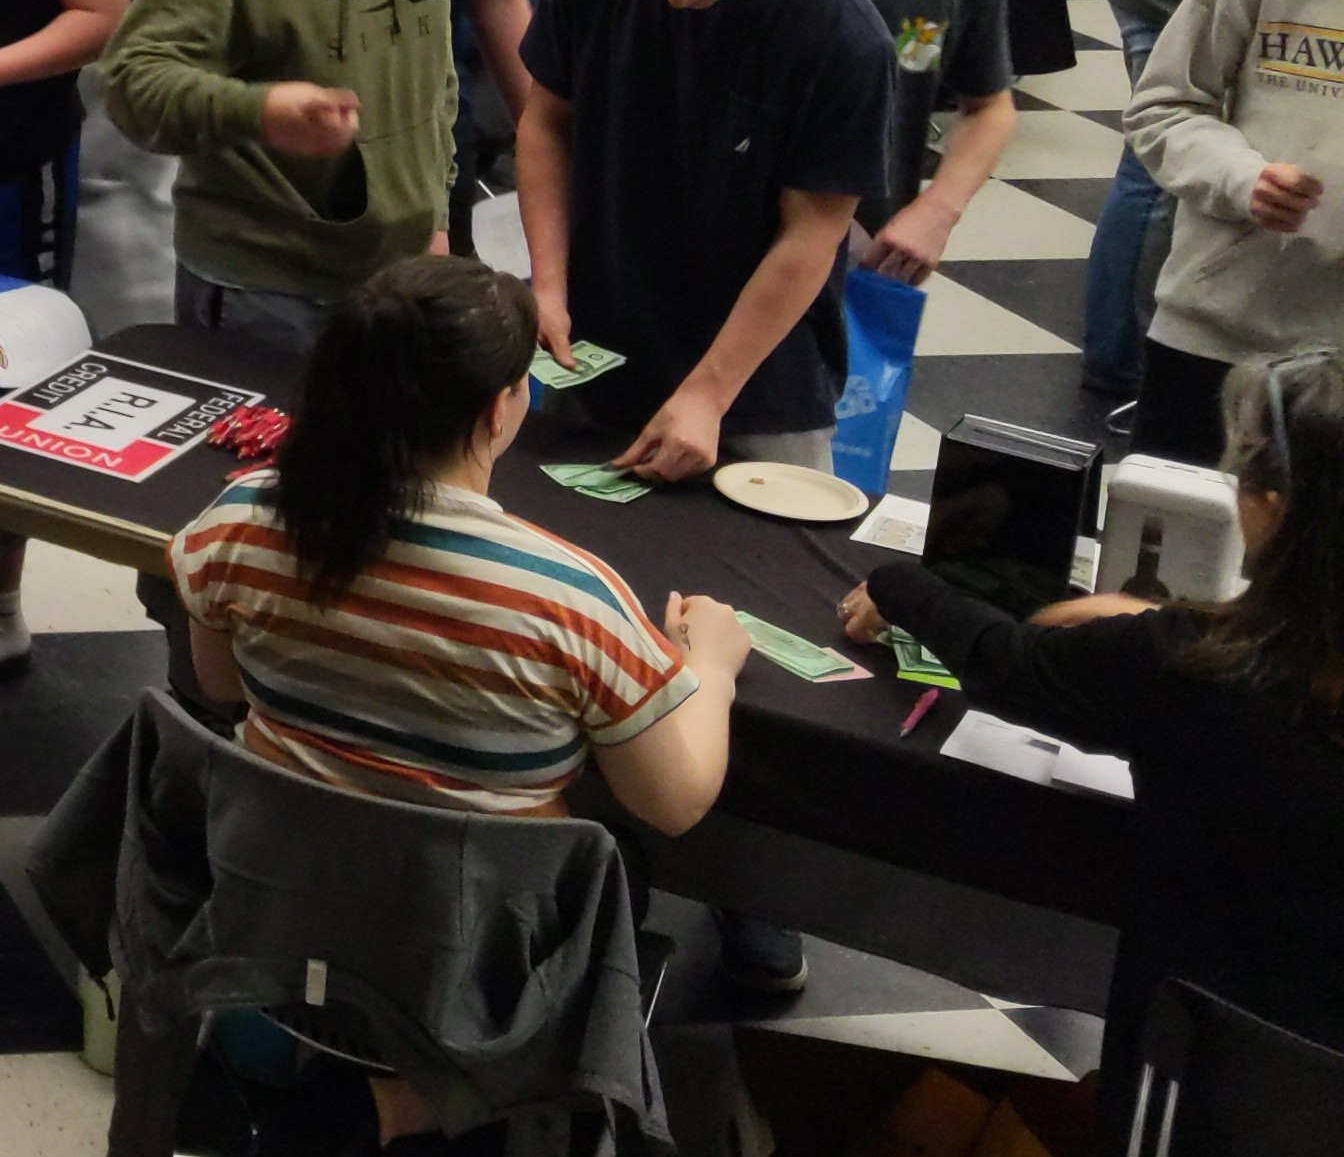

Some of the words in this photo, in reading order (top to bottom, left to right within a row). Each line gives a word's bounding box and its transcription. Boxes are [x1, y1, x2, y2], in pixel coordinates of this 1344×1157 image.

[1255, 71, 1289, 89] THE
[32, 362, 108, 406] CREDIT
[62, 391, 159, 430] R.I.A.
[156, 391, 245, 440] FEDERAL
